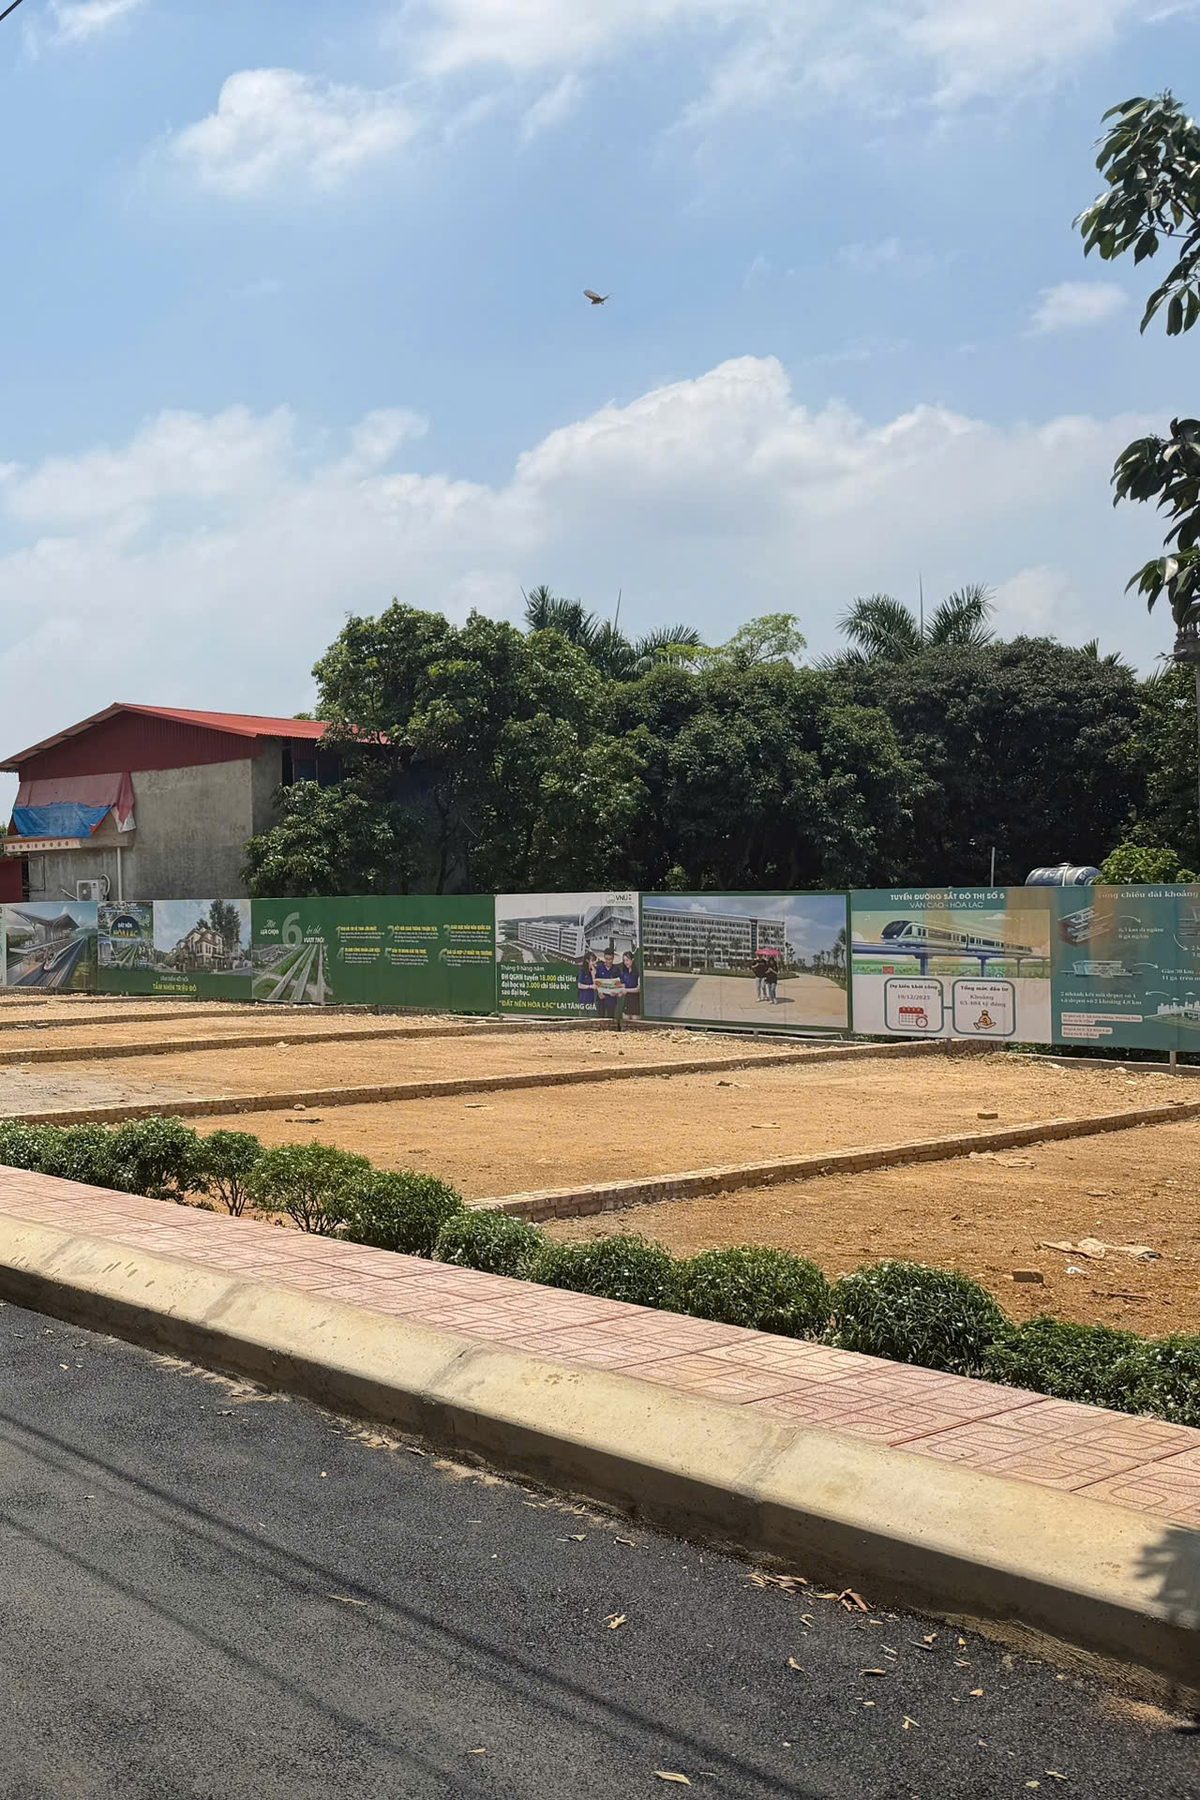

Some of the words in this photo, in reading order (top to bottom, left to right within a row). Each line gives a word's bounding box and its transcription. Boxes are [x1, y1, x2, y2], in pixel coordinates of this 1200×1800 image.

[890, 892, 912, 900] TUYẾN
[914, 892, 942, 900] ĐƯỜNG
[944, 891, 956, 900] SẮT
[959, 891, 971, 900] ĐÔ
[973, 892, 984, 901] THỊ
[987, 890, 998, 900] SỐ
[950, 900, 966, 908] HÒA
[968, 902, 984, 910] LẠC
[282, 912, 302, 947] 6
[557, 1002, 566, 1010] LẠI
